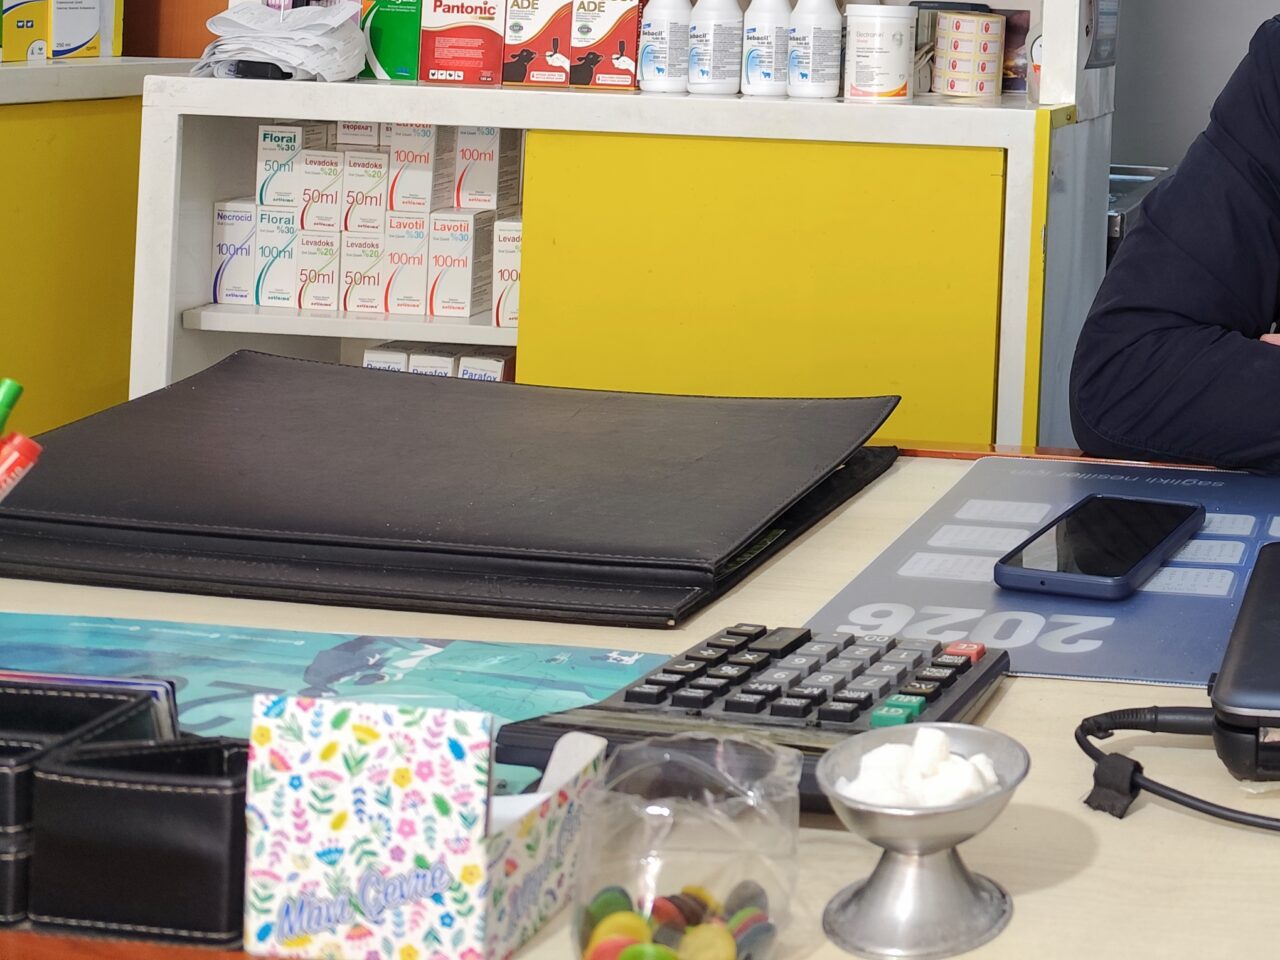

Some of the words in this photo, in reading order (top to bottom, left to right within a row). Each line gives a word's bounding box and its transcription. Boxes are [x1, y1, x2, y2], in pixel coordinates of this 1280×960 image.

[577, 1, 605, 13] ADE
[342, 124, 372, 133] Levadoks
[262, 133, 297, 144] Floral
[277, 144, 296, 152] %30
[264, 159, 294, 173] 50ml
[305, 158, 339, 167] Levadoks
[348, 159, 383, 169] Levadoks
[302, 189, 338, 205] 50ml
[346, 191, 382, 207] 50ml
[217, 212, 253, 222] Necrocid
[260, 213, 295, 225] Floral
[389, 219, 425, 230] Lavotil
[433, 221, 469, 233] Lavotil
[301, 239, 334, 247] Levadoks
[346, 240, 380, 249] Levadoks
[216, 243, 251, 257] 100ml
[299, 268, 335, 284] 50ml
[344, 271, 380, 286] 50ml
[462, 369, 498, 381] Parafox
[836, 602, 1116, 654] 2026
[958, 642, 979, 650] CE
[868, 677, 879, 686] 7
[838, 690, 868, 700] MRC
[894, 695, 918, 703] MU
[883, 707, 904, 716] GT
